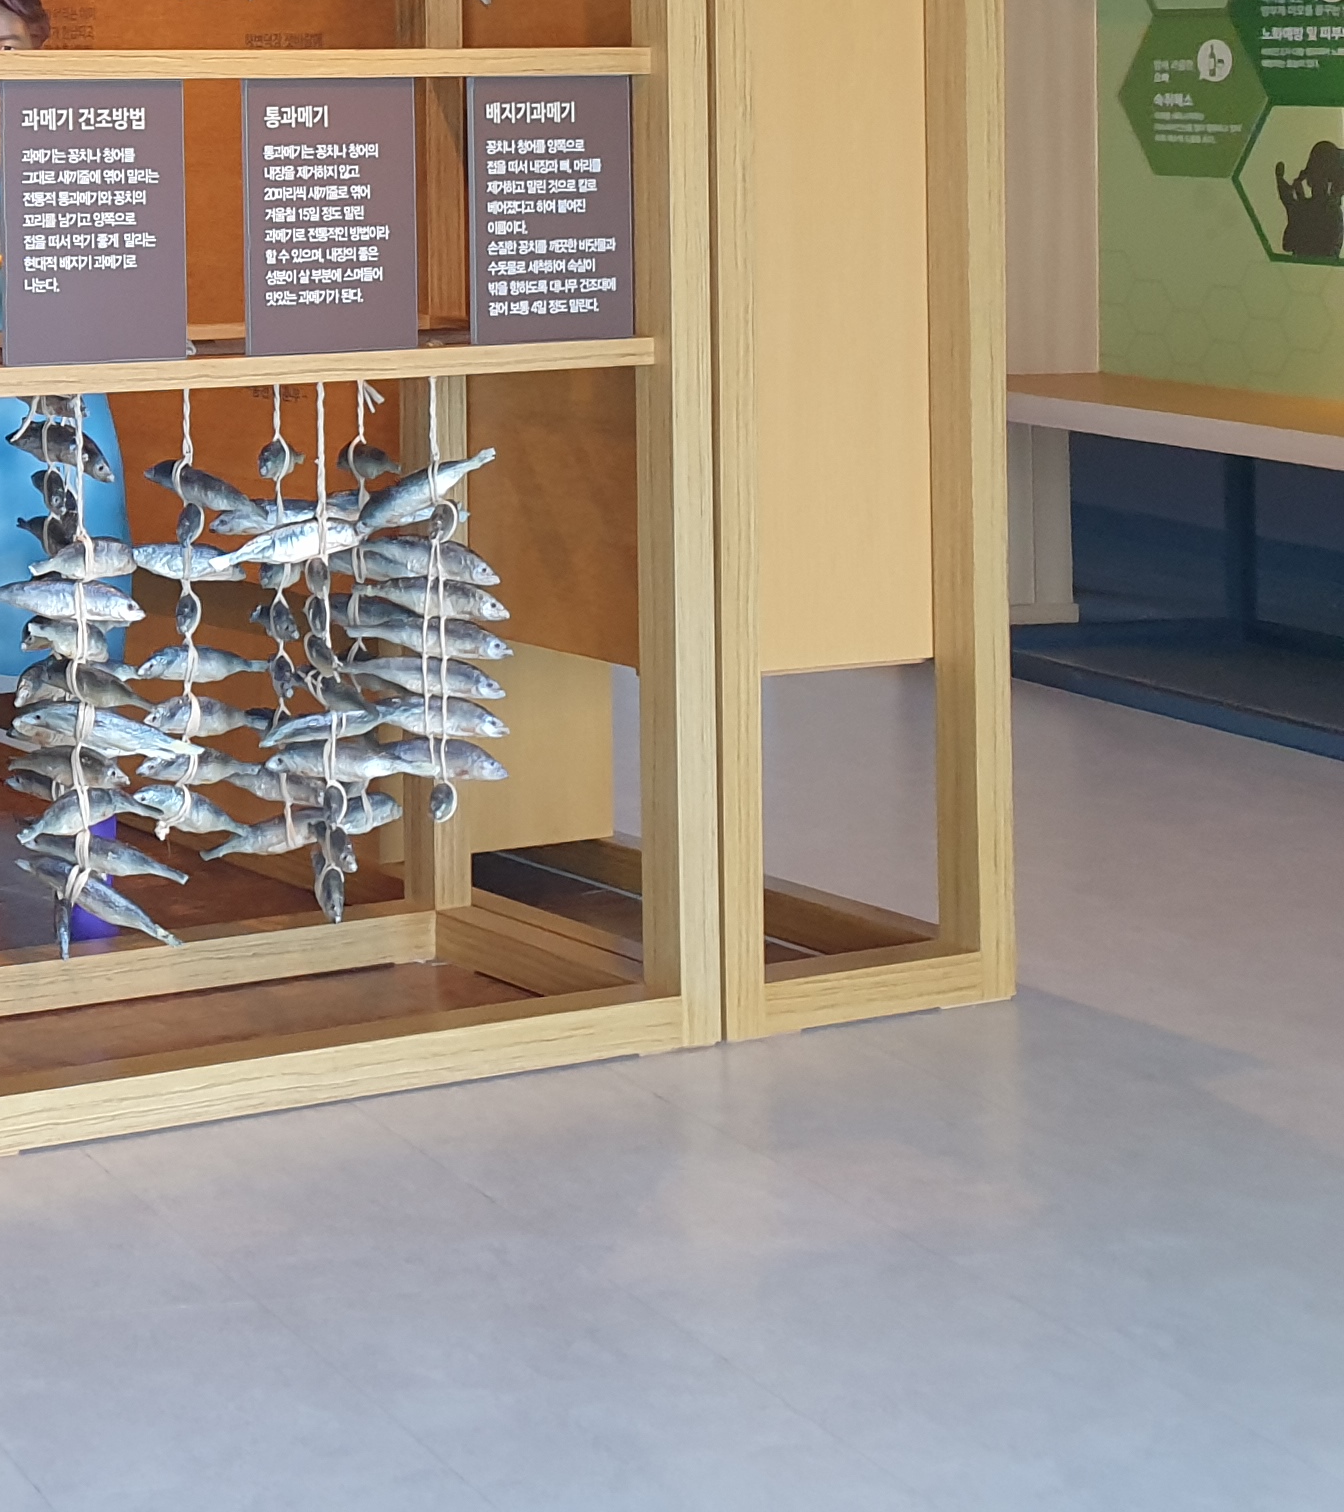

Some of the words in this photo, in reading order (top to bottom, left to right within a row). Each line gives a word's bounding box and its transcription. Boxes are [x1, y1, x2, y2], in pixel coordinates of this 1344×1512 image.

[21, 107, 73, 131] 과메기
[78, 107, 145, 131] 건조방법
[263, 105, 329, 129] 통과메기
[485, 101, 575, 124] 배지기과메기
